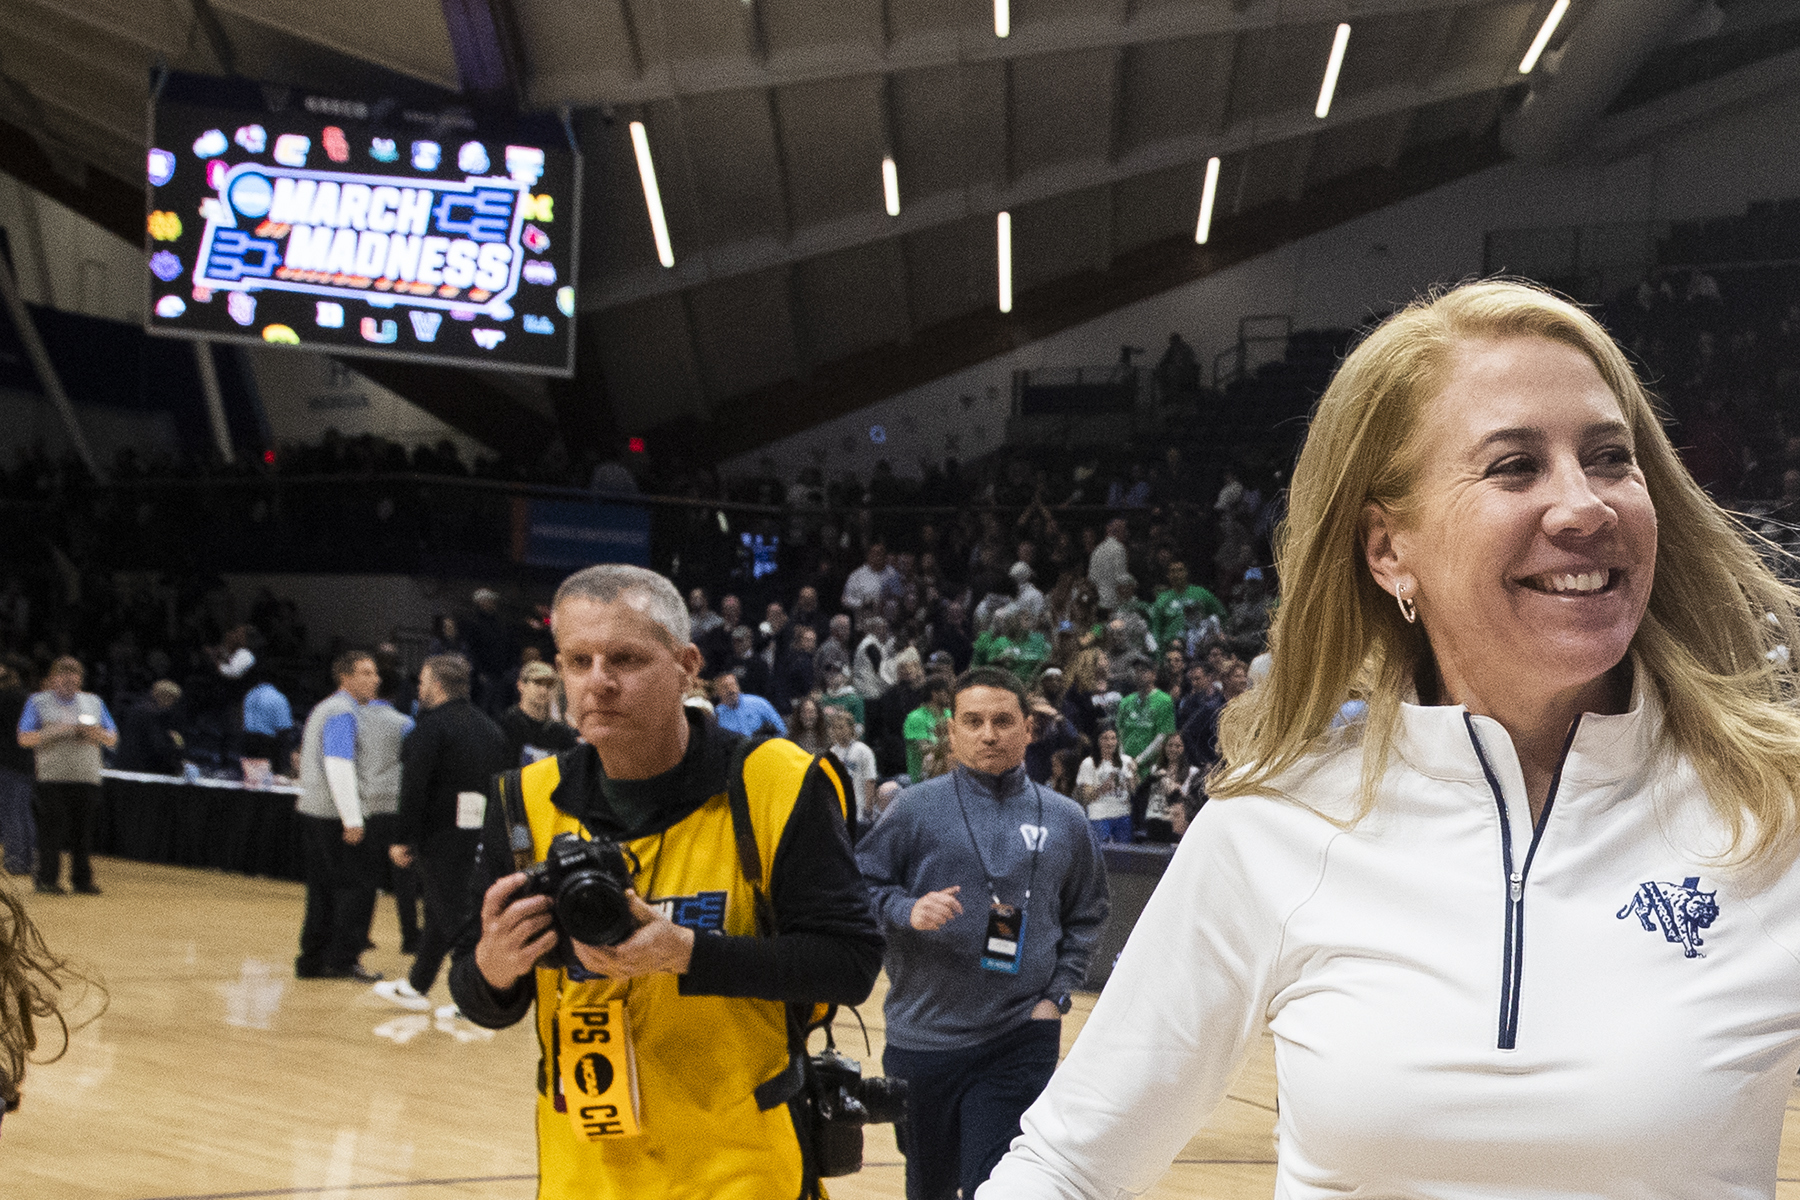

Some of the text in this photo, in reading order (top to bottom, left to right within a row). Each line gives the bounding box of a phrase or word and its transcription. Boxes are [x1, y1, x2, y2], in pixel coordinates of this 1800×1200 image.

[270, 177, 434, 235] MARCH
[284, 225, 512, 291] MADNESS
[1645, 883, 1676, 937] VILLANOVA
